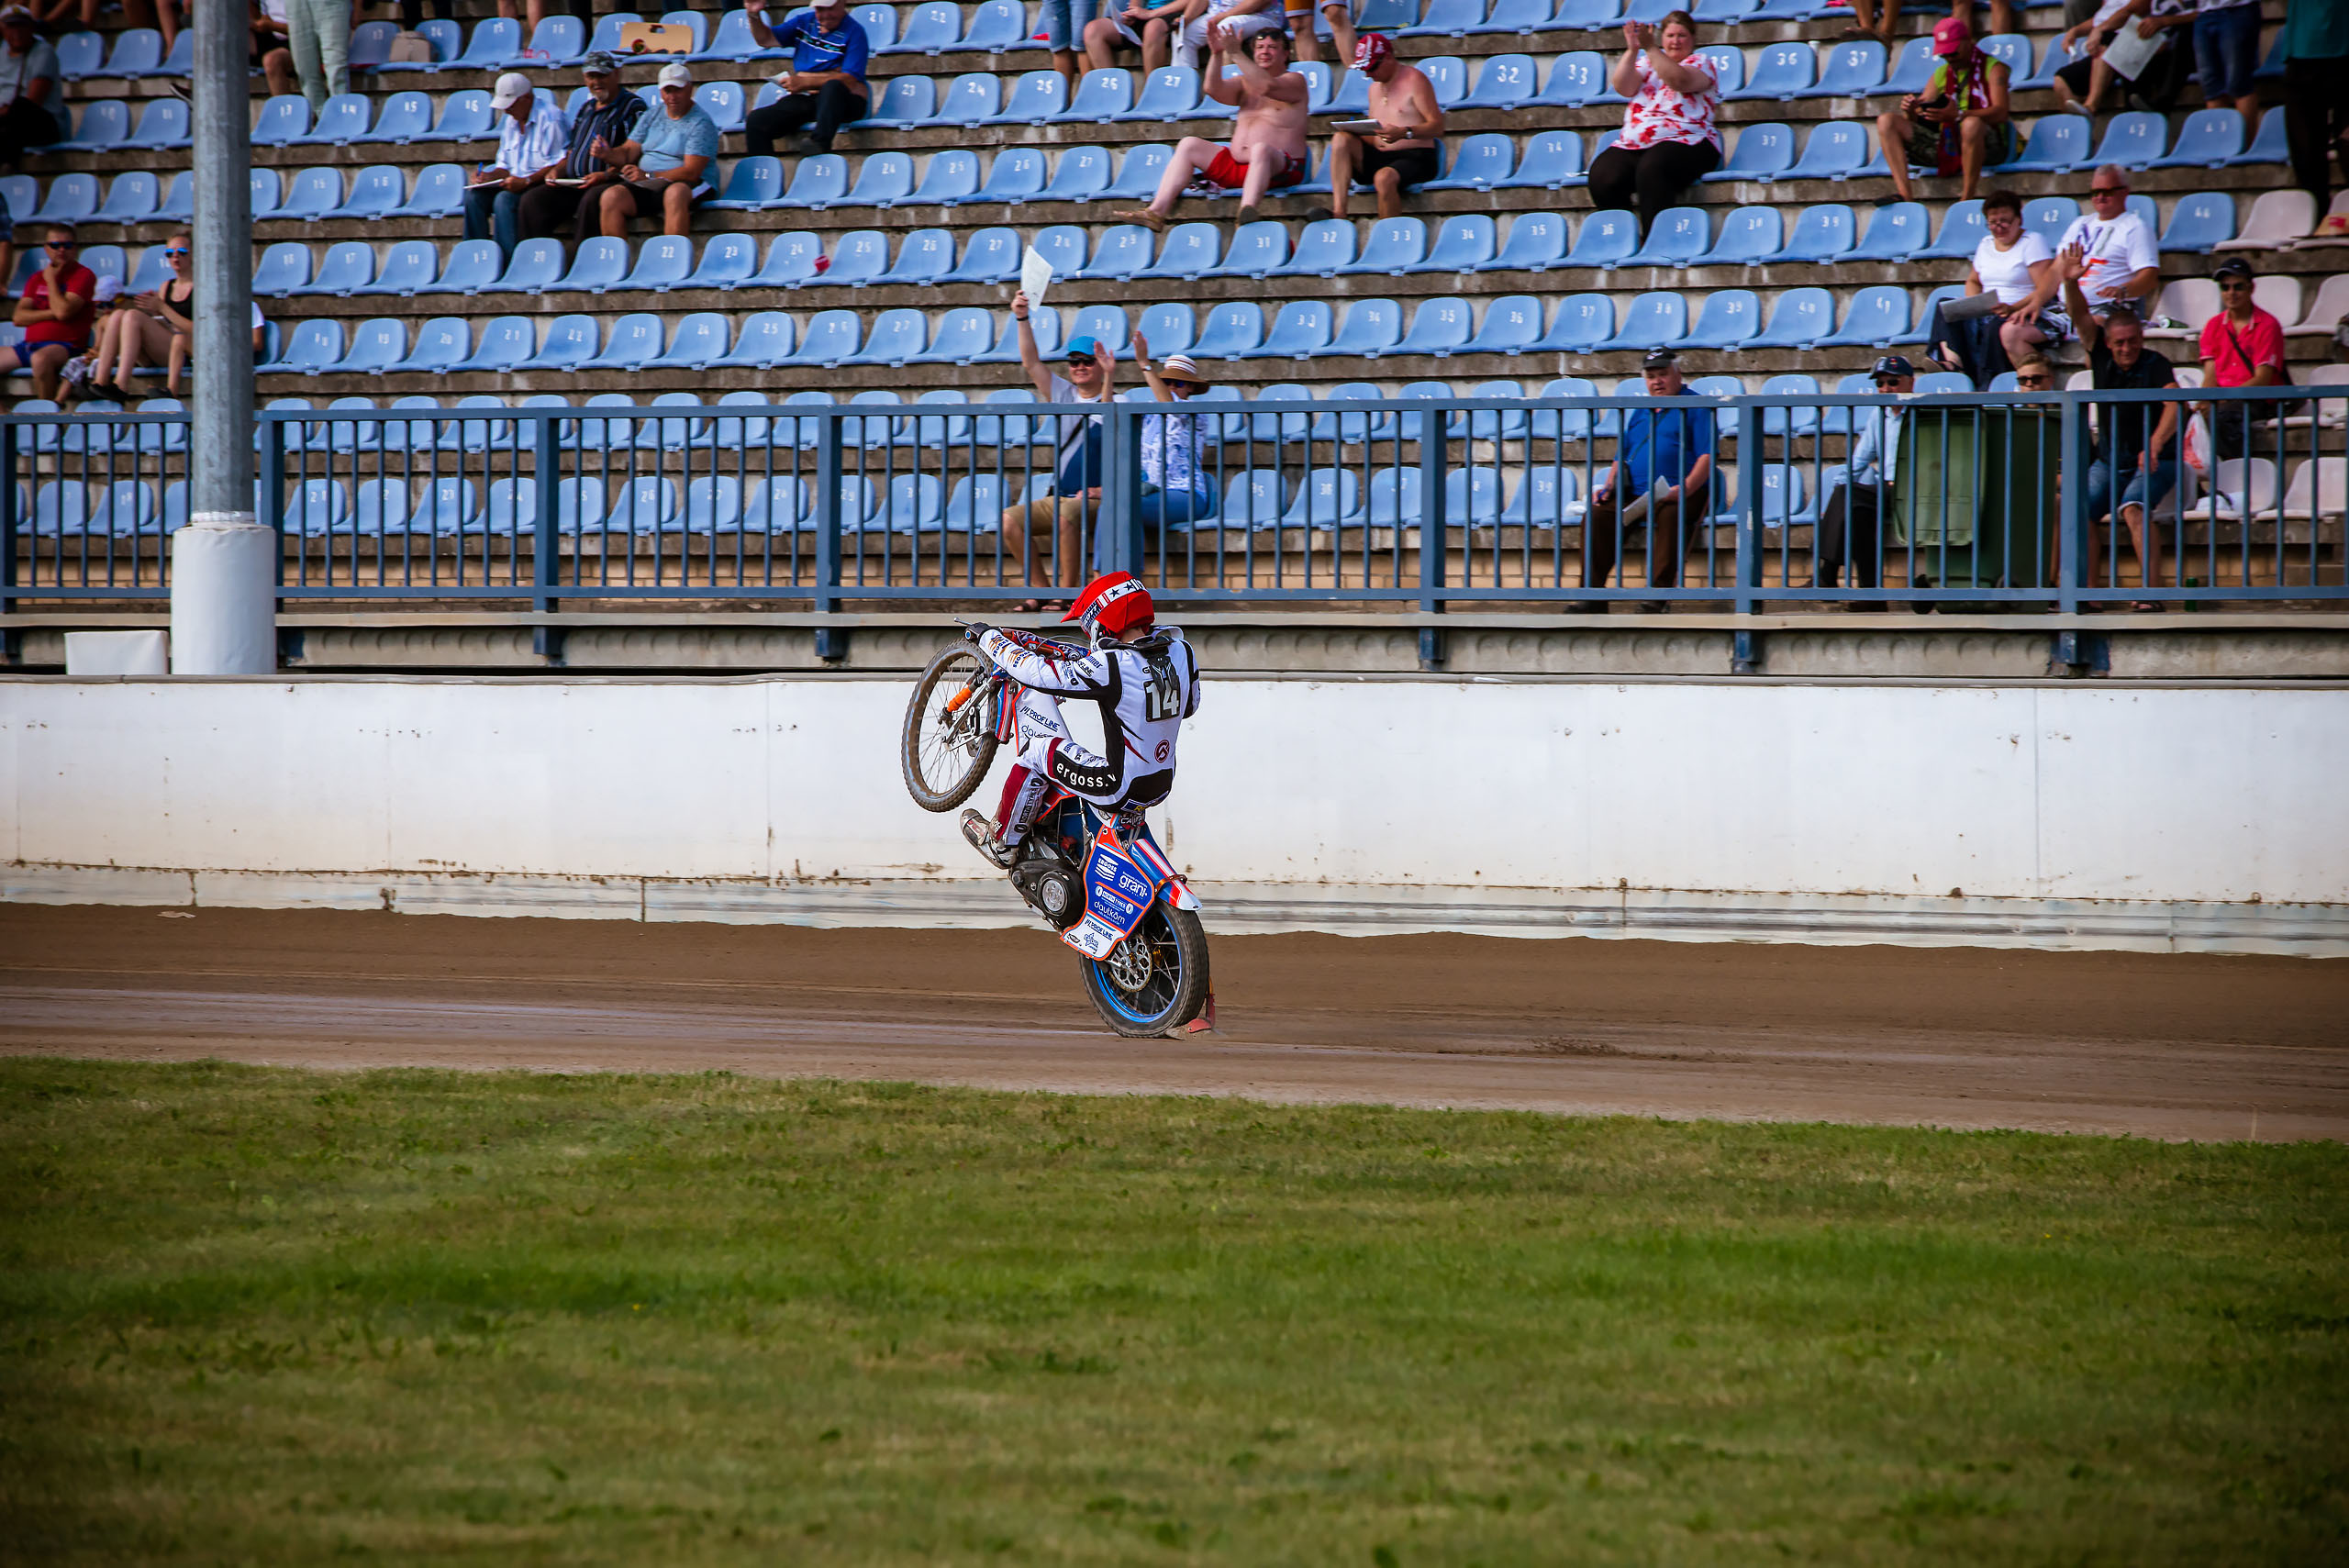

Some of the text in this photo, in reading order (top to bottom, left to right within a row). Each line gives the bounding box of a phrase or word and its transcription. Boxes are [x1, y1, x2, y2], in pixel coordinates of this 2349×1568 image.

[869, 11, 884, 23] 21
[1990, 43, 2014, 59] 39
[1776, 52, 1798, 66] 36
[1847, 50, 1868, 67] 37
[1164, 74, 1181, 87] 27
[1429, 65, 1447, 82] 31
[1497, 64, 1520, 83] 32
[1568, 63, 1588, 85] 33
[901, 83, 916, 96] 23
[968, 81, 985, 96] 24
[1036, 79, 1053, 95] 25
[1100, 76, 1118, 91] 26
[711, 89, 729, 106] 20
[404, 100, 417, 113] 15
[465, 99, 479, 113] 16
[1483, 146, 1497, 157] 33
[1078, 155, 1093, 168] 27
[753, 168, 769, 180] 22
[1966, 213, 1981, 226] 41
[2043, 209, 2059, 223] 42
[1675, 218, 1691, 233] 37
[1322, 230, 1337, 243] 32
[1392, 229, 1411, 242] 33
[661, 245, 674, 259] 22
[724, 245, 739, 259] 23
[988, 239, 1003, 251] 27
[1763, 474, 1778, 489] 42
[640, 488, 655, 504] 26
[1146, 681, 1180, 719] 14
